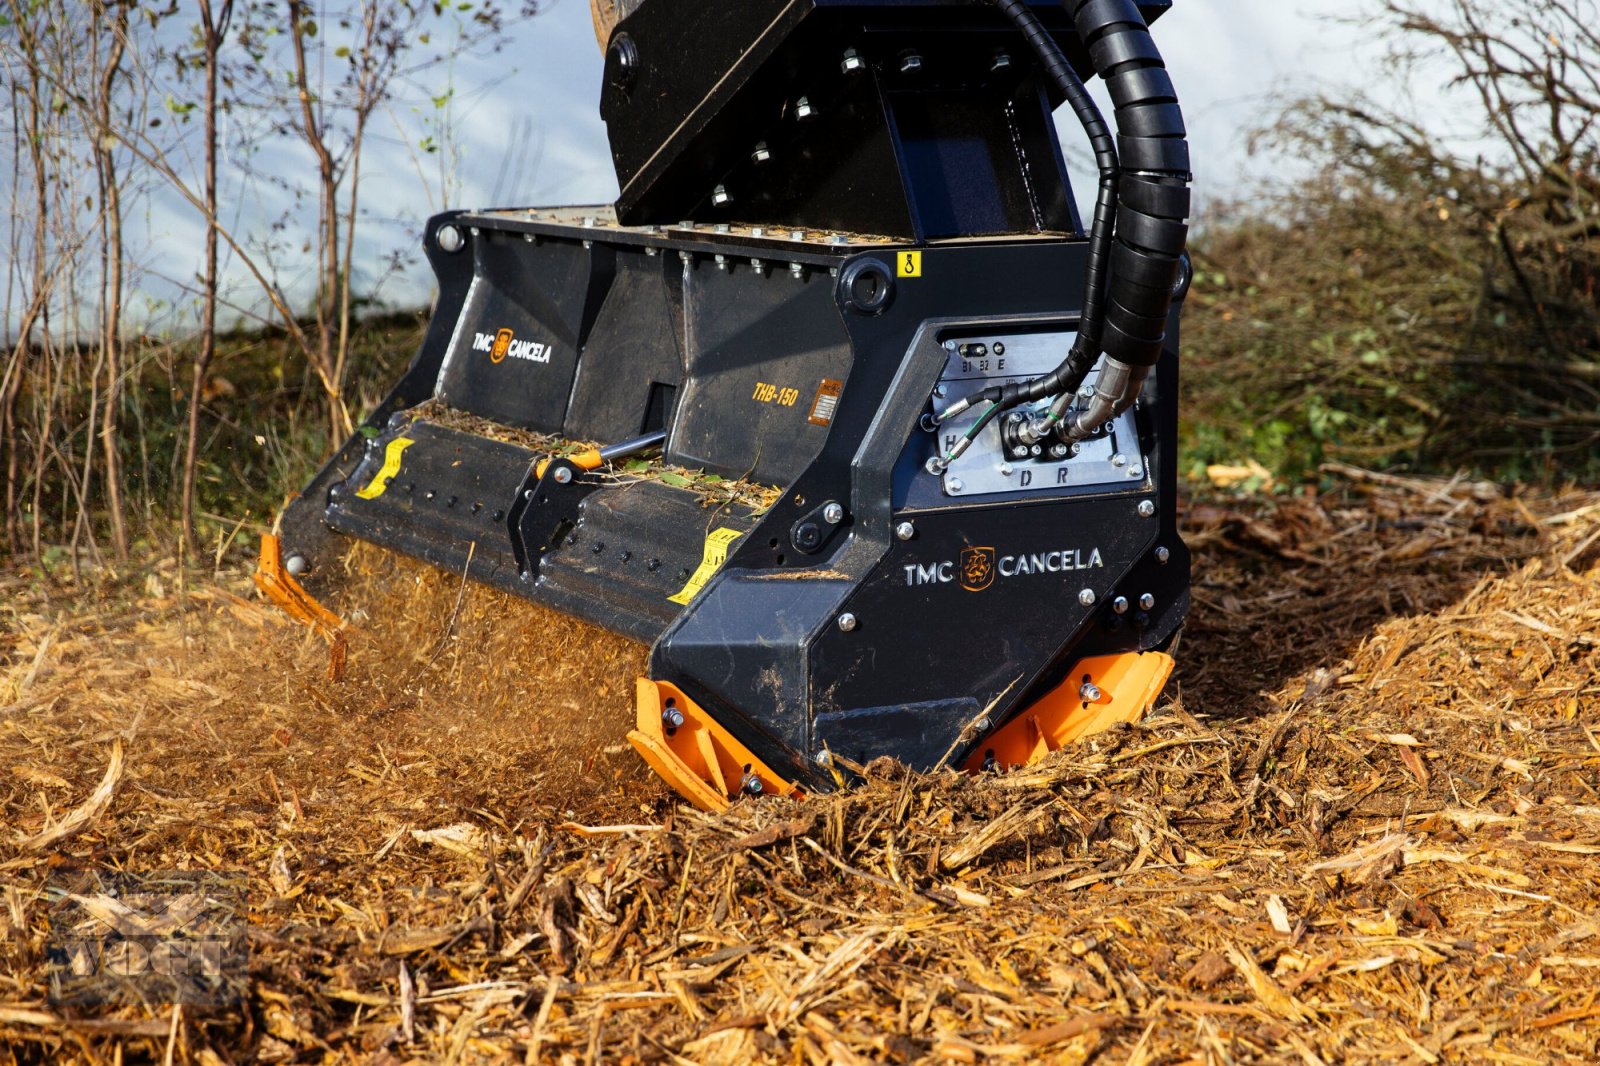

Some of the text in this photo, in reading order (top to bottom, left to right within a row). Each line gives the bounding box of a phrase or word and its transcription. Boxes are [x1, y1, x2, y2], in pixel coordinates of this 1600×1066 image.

[472, 332, 552, 364] TMC CANCELA
[997, 359, 1005, 370] E
[752, 382, 799, 407] THB-150
[1020, 467, 1069, 487] D R
[903, 547, 1104, 586] TMC CANCELA
